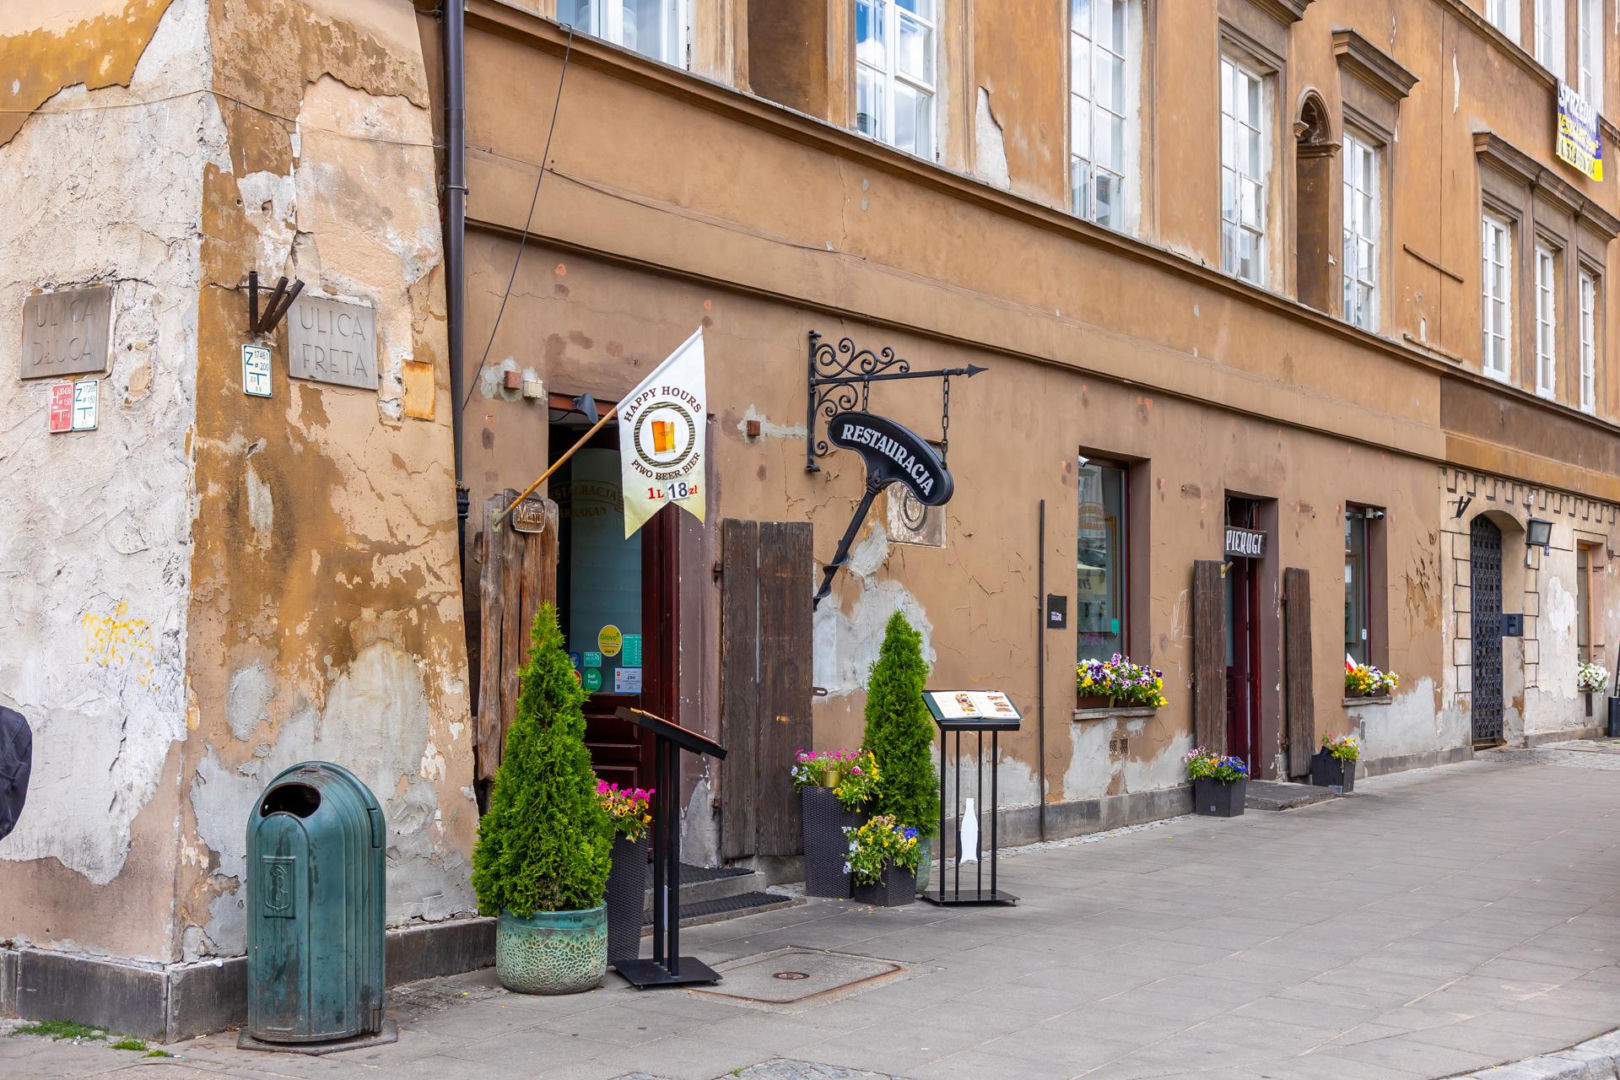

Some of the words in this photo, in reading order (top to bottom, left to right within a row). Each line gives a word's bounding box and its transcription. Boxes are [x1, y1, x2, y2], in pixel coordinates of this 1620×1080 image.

[36, 297, 95, 328] ULICA
[299, 305, 366, 341] ULICA
[246, 351, 254, 366] Z
[302, 343, 369, 378] FRETA
[76, 388, 82, 402] Z
[624, 388, 657, 423] HAPPY
[662, 386, 702, 413] HOURS
[632, 459, 653, 478] PIWO
[655, 470, 682, 481] BEER
[683, 452, 701, 474] BIER
[841, 424, 934, 496] RESTAURACJA
[1226, 529, 1263, 555] PIEROGI
